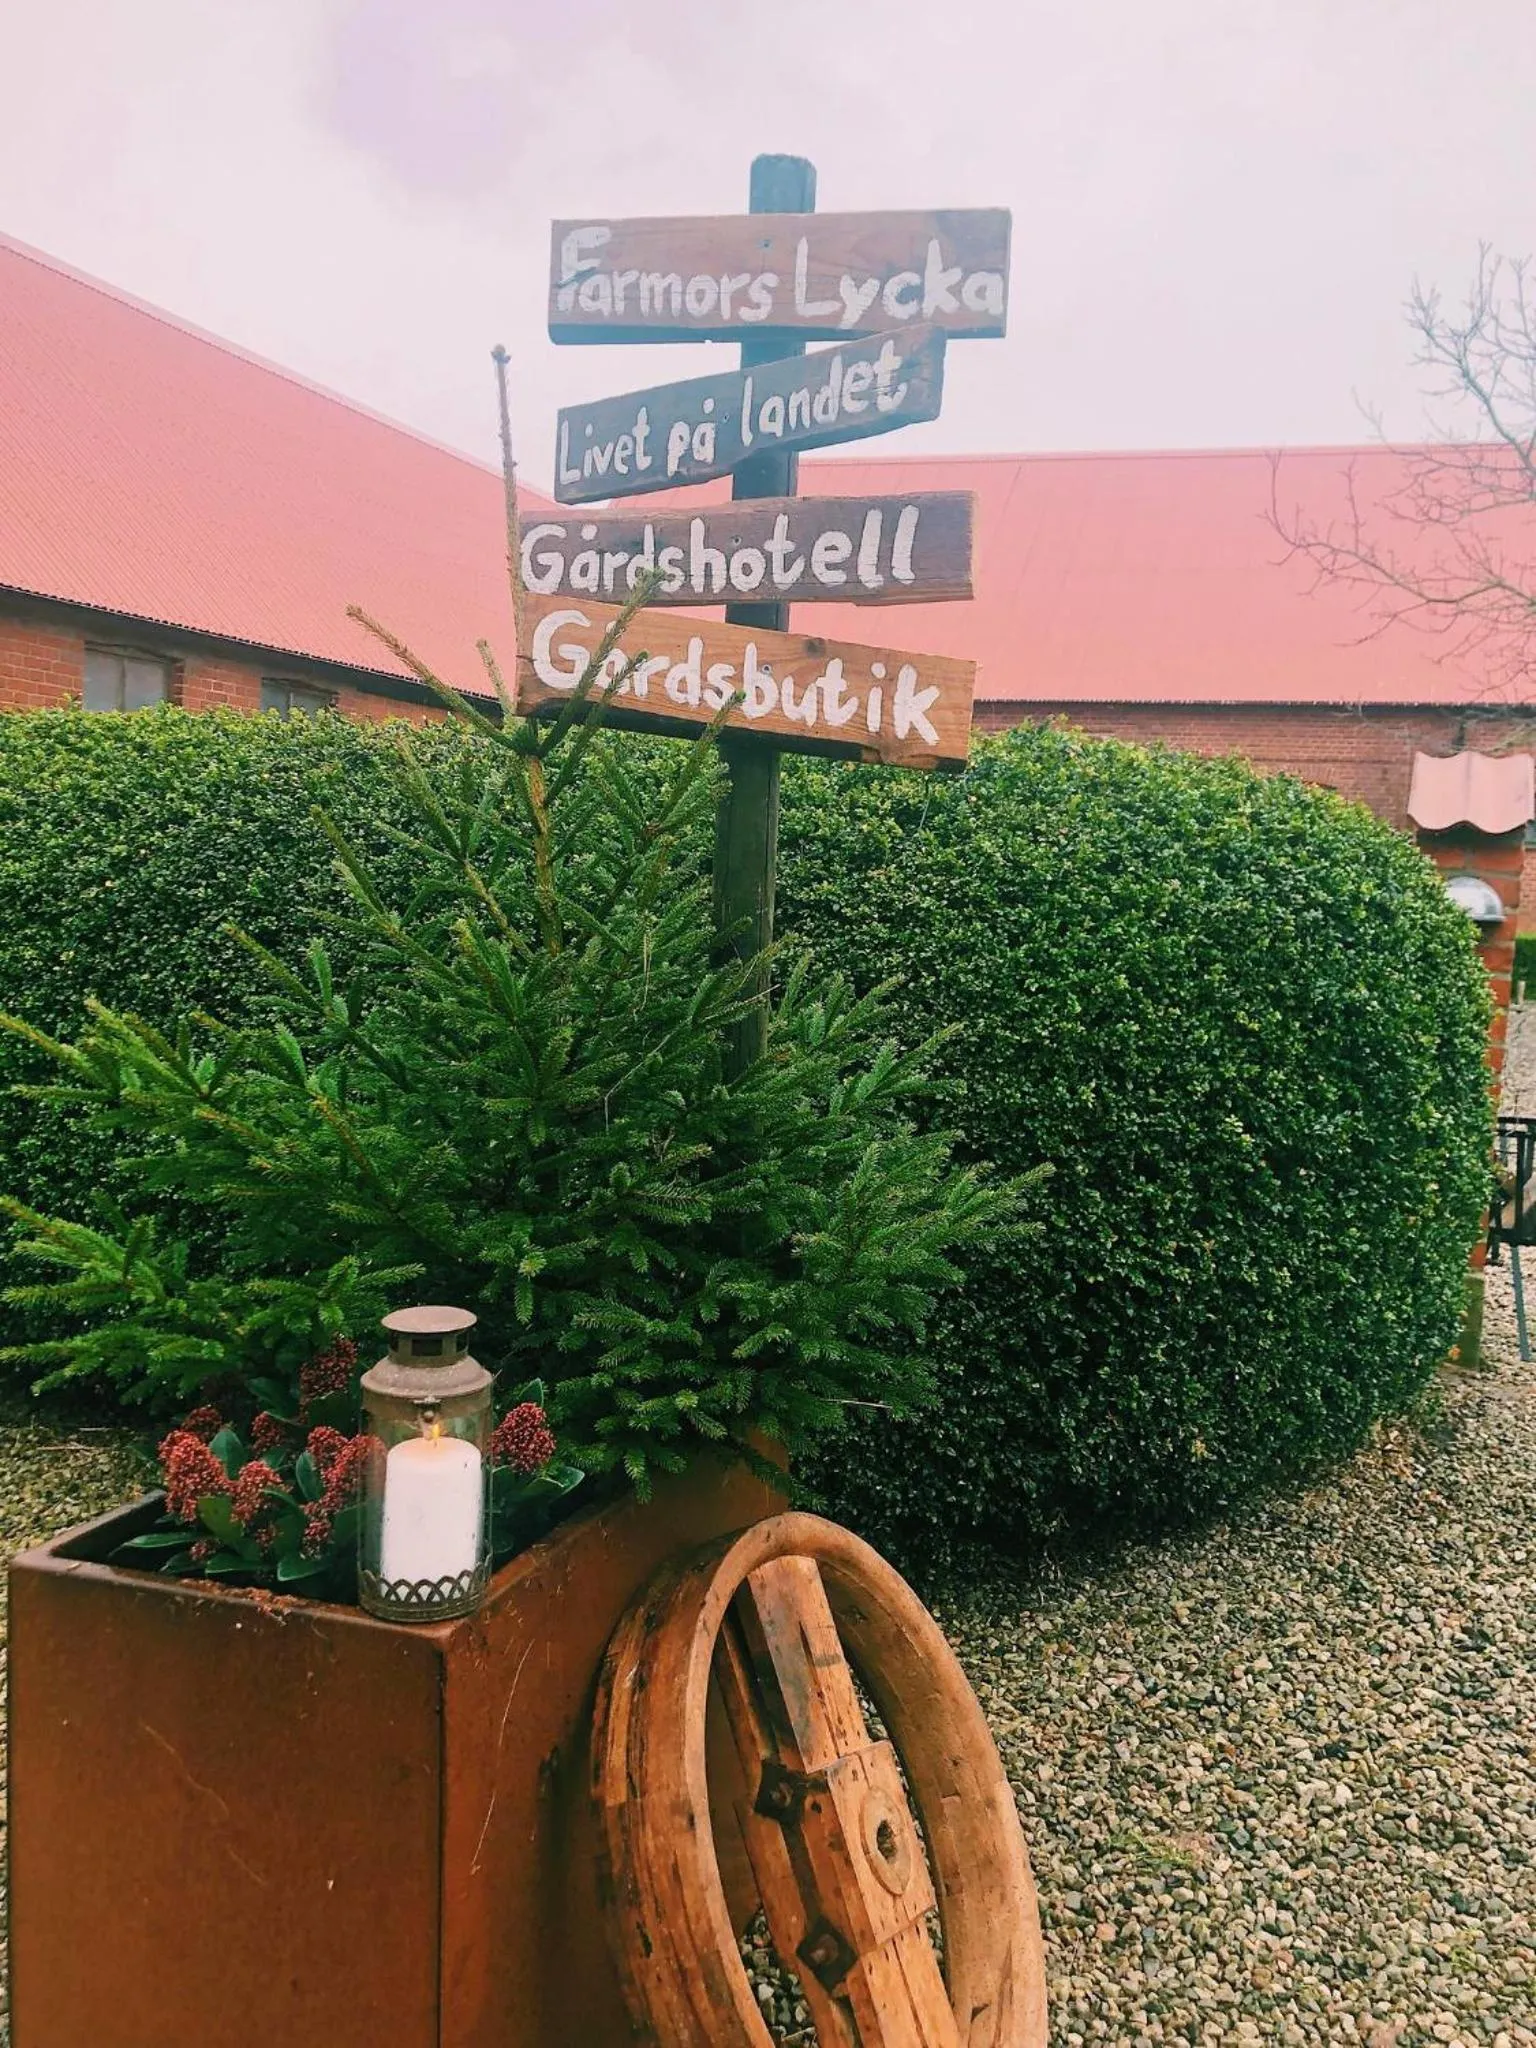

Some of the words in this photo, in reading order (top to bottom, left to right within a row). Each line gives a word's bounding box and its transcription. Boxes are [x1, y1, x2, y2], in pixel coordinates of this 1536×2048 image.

[557, 226, 779, 321] Farmors
[795, 236, 1004, 328] Lycka
[559, 407, 653, 485] Livet
[667, 398, 716, 477] på
[741, 340, 906, 446] landet
[520, 505, 919, 595] Gårdshotell
